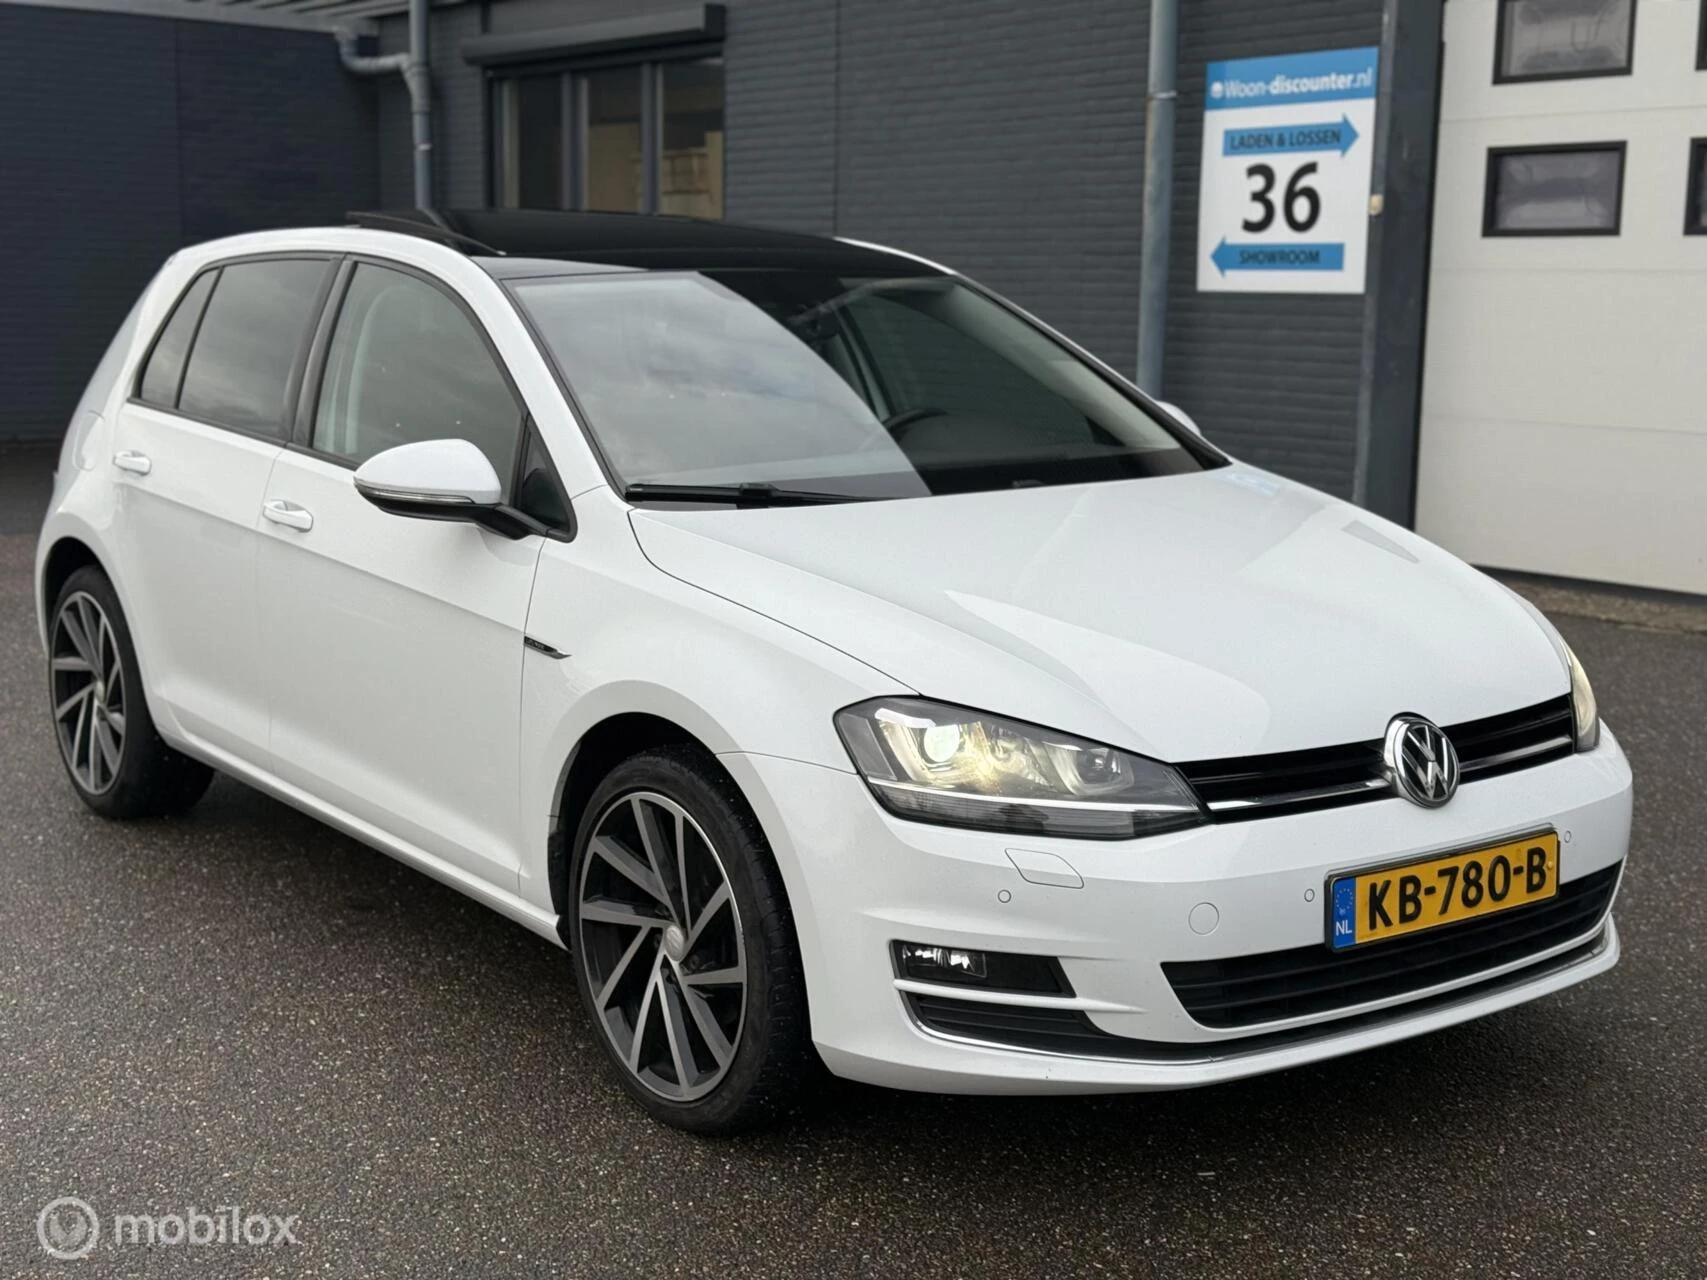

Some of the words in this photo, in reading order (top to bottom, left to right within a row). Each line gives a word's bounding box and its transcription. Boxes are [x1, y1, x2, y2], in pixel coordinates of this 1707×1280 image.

[1225, 66, 1374, 99] Woon-discounter.nl
[1230, 132, 1273, 150] LADEN
[1276, 131, 1286, 148] &
[1289, 128, 1341, 147] LOSSEN
[1242, 161, 1321, 233] 36
[1239, 249, 1321, 264] SHOWROOM
[1368, 846, 1548, 930] KB-780-B
[1335, 920, 1352, 936] NL
